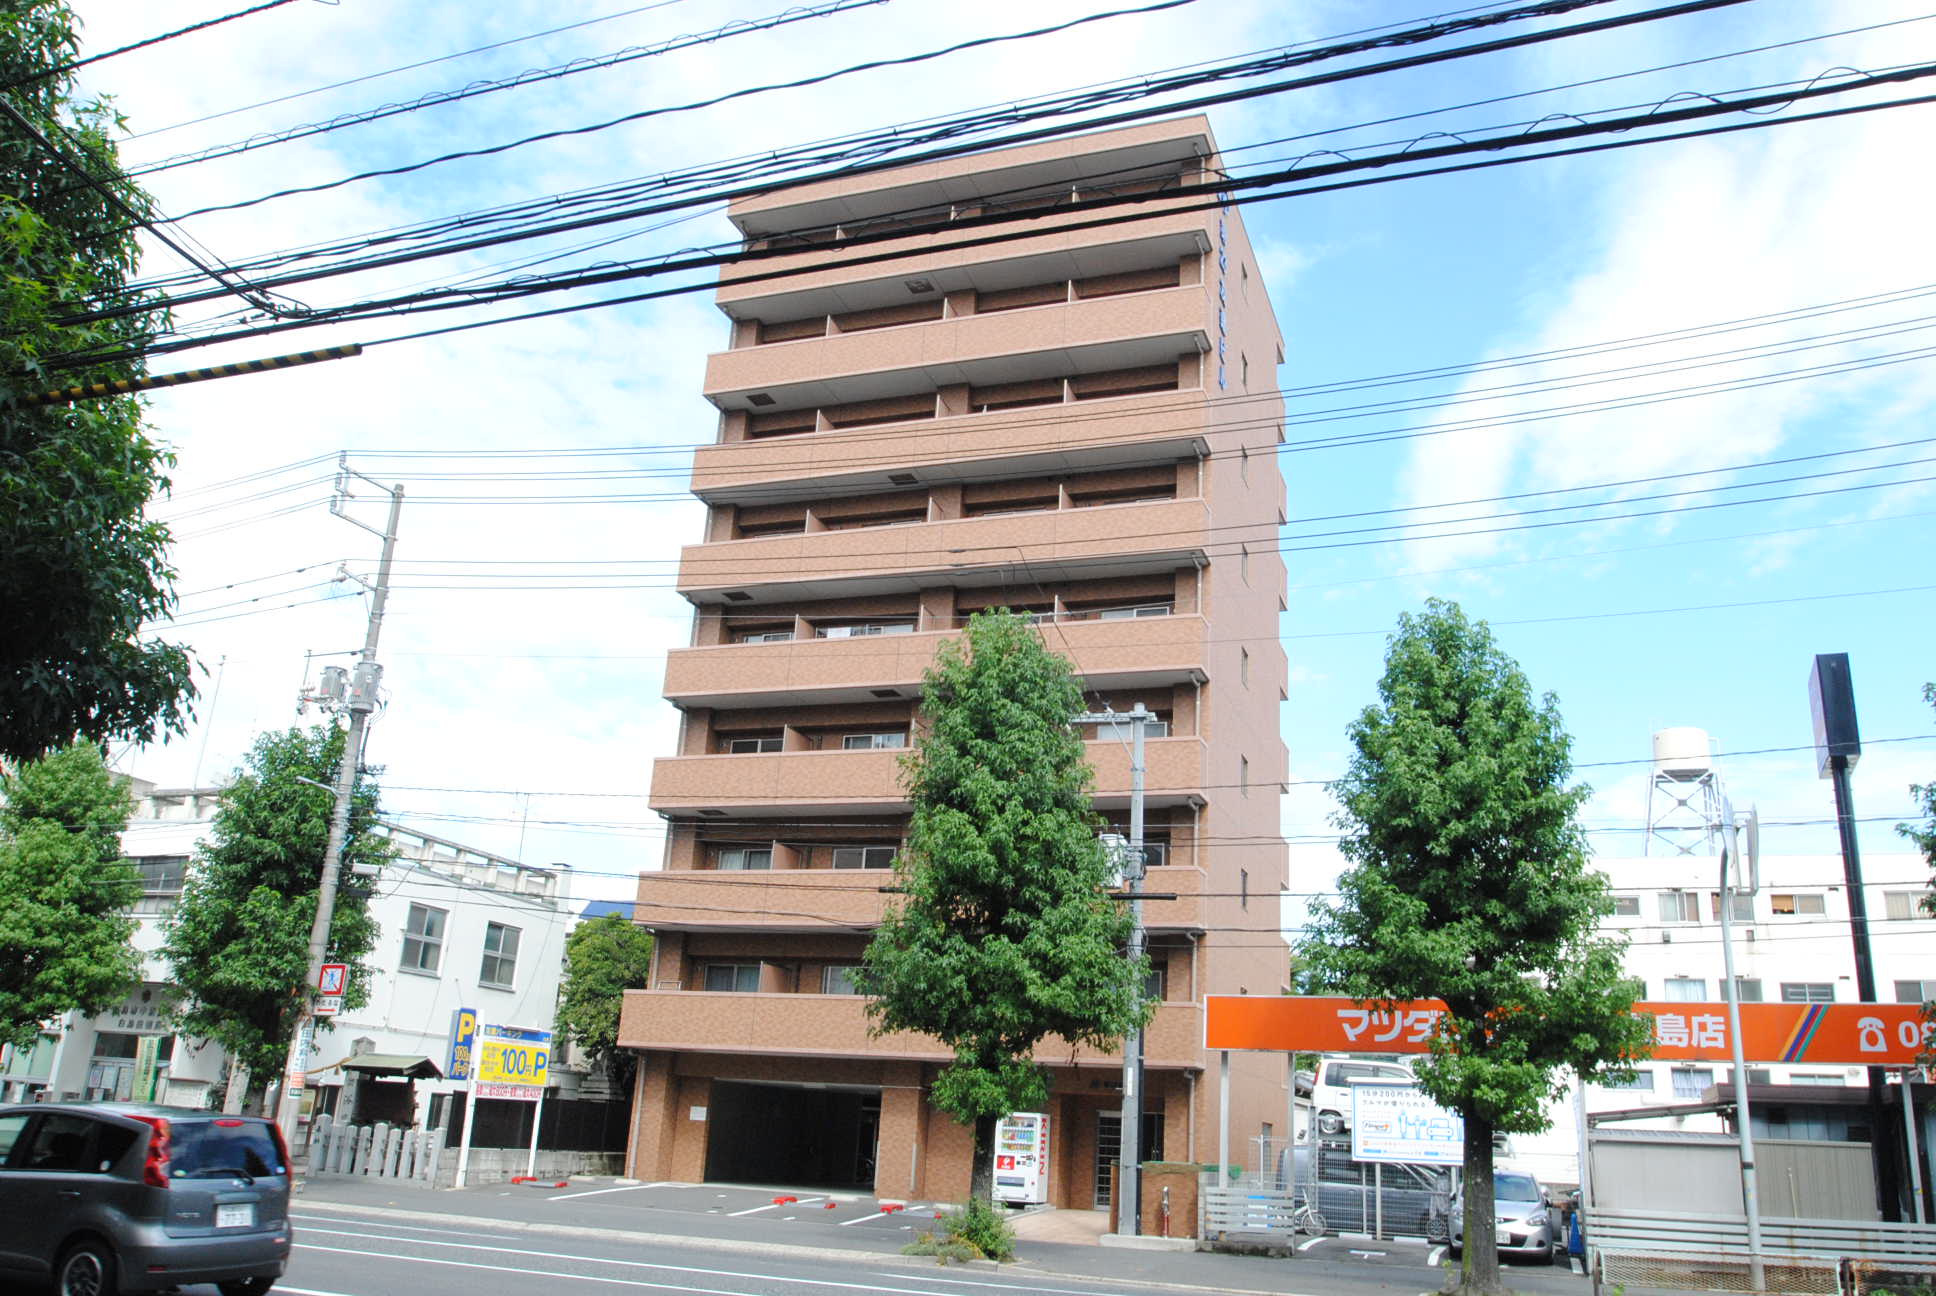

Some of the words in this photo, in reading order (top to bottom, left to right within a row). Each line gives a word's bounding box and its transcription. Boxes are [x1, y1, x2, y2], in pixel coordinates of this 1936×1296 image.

[456, 1012, 476, 1043] P
[1634, 1012, 1726, 1048] 島店
[533, 1051, 548, 1077] P
